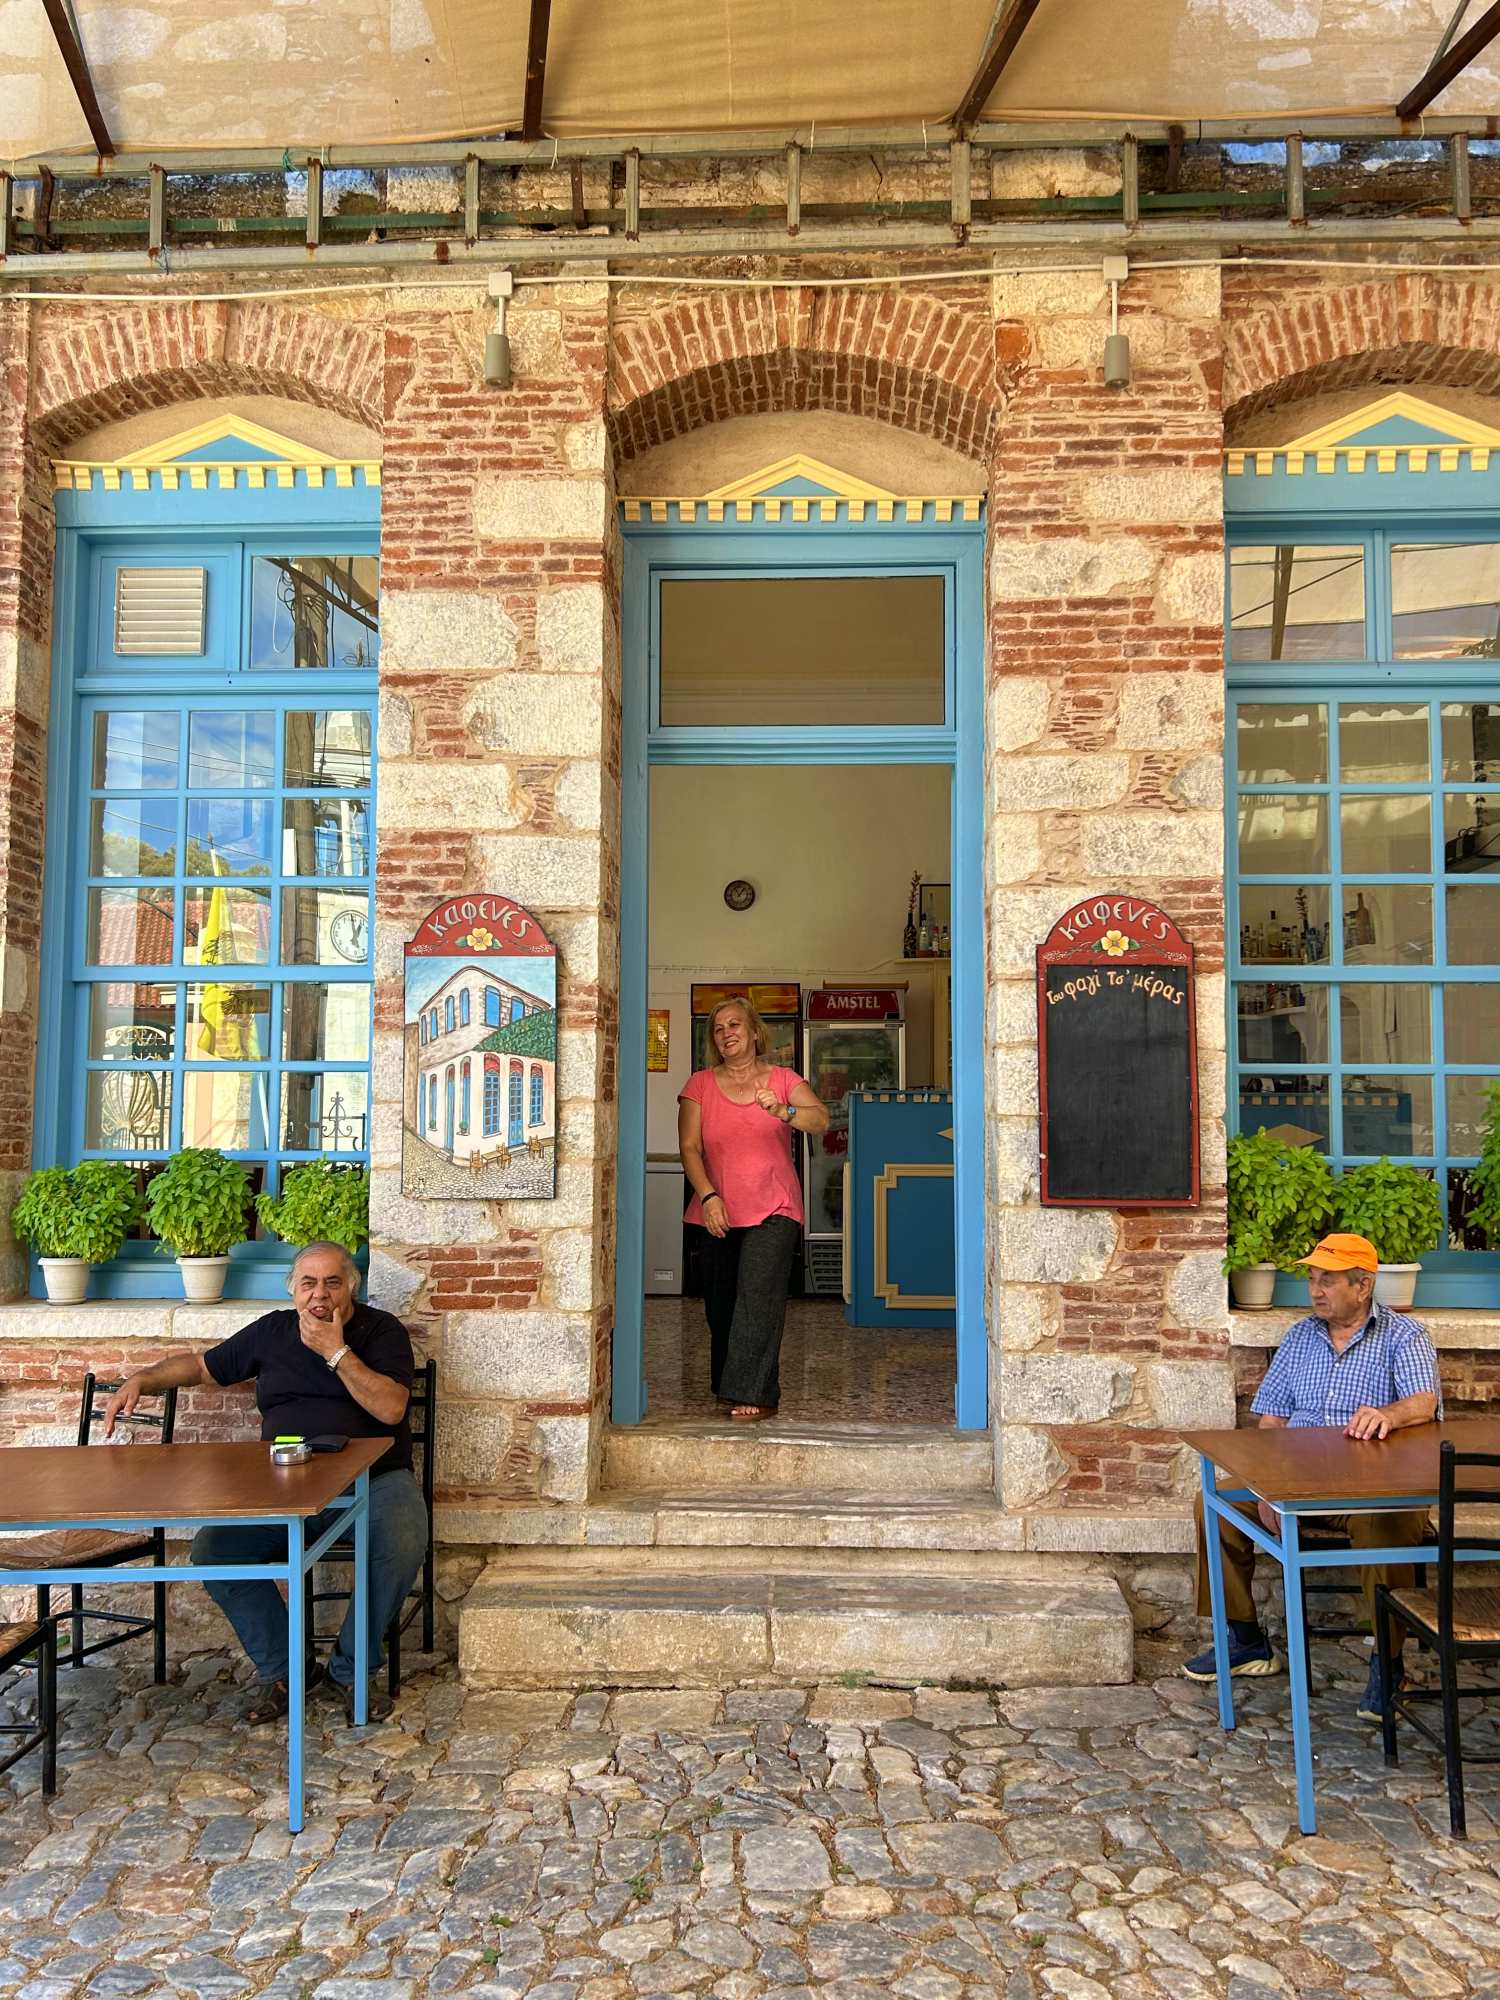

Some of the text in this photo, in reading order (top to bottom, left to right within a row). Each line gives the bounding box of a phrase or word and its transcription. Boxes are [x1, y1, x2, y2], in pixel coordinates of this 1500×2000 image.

[1064, 968, 1102, 1001] φαγί
[1131, 970, 1185, 1005] μέρας
[826, 995, 881, 1009] AMSTEL
